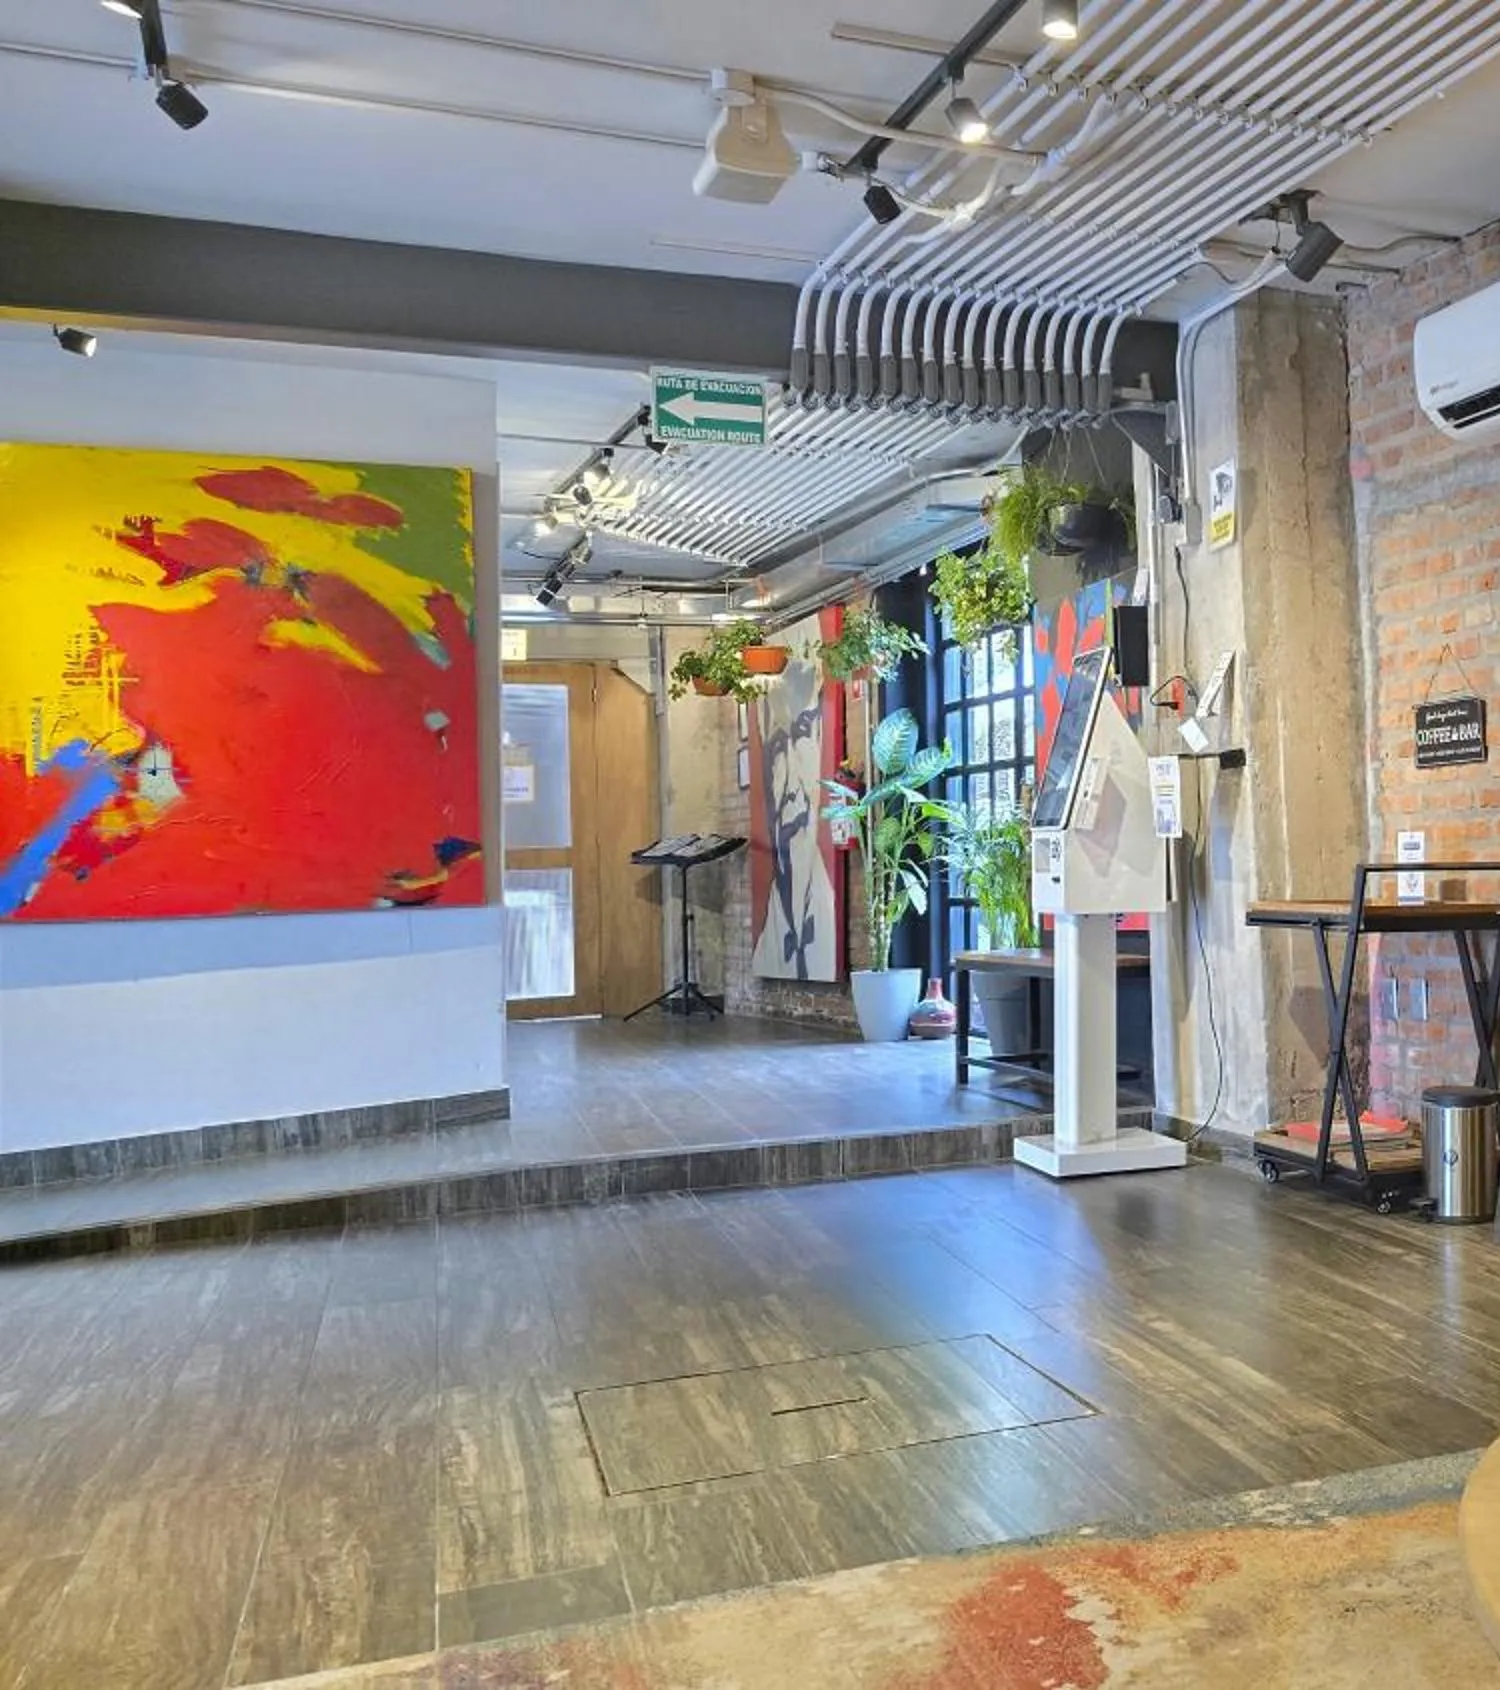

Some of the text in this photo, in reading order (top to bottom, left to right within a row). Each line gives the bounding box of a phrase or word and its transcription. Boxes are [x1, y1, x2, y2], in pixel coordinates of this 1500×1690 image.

[685, 379, 699, 391] DE
[659, 425, 761, 444] EVACUATION ROUTE
[1416, 721, 1481, 746] COFFEE BAR
